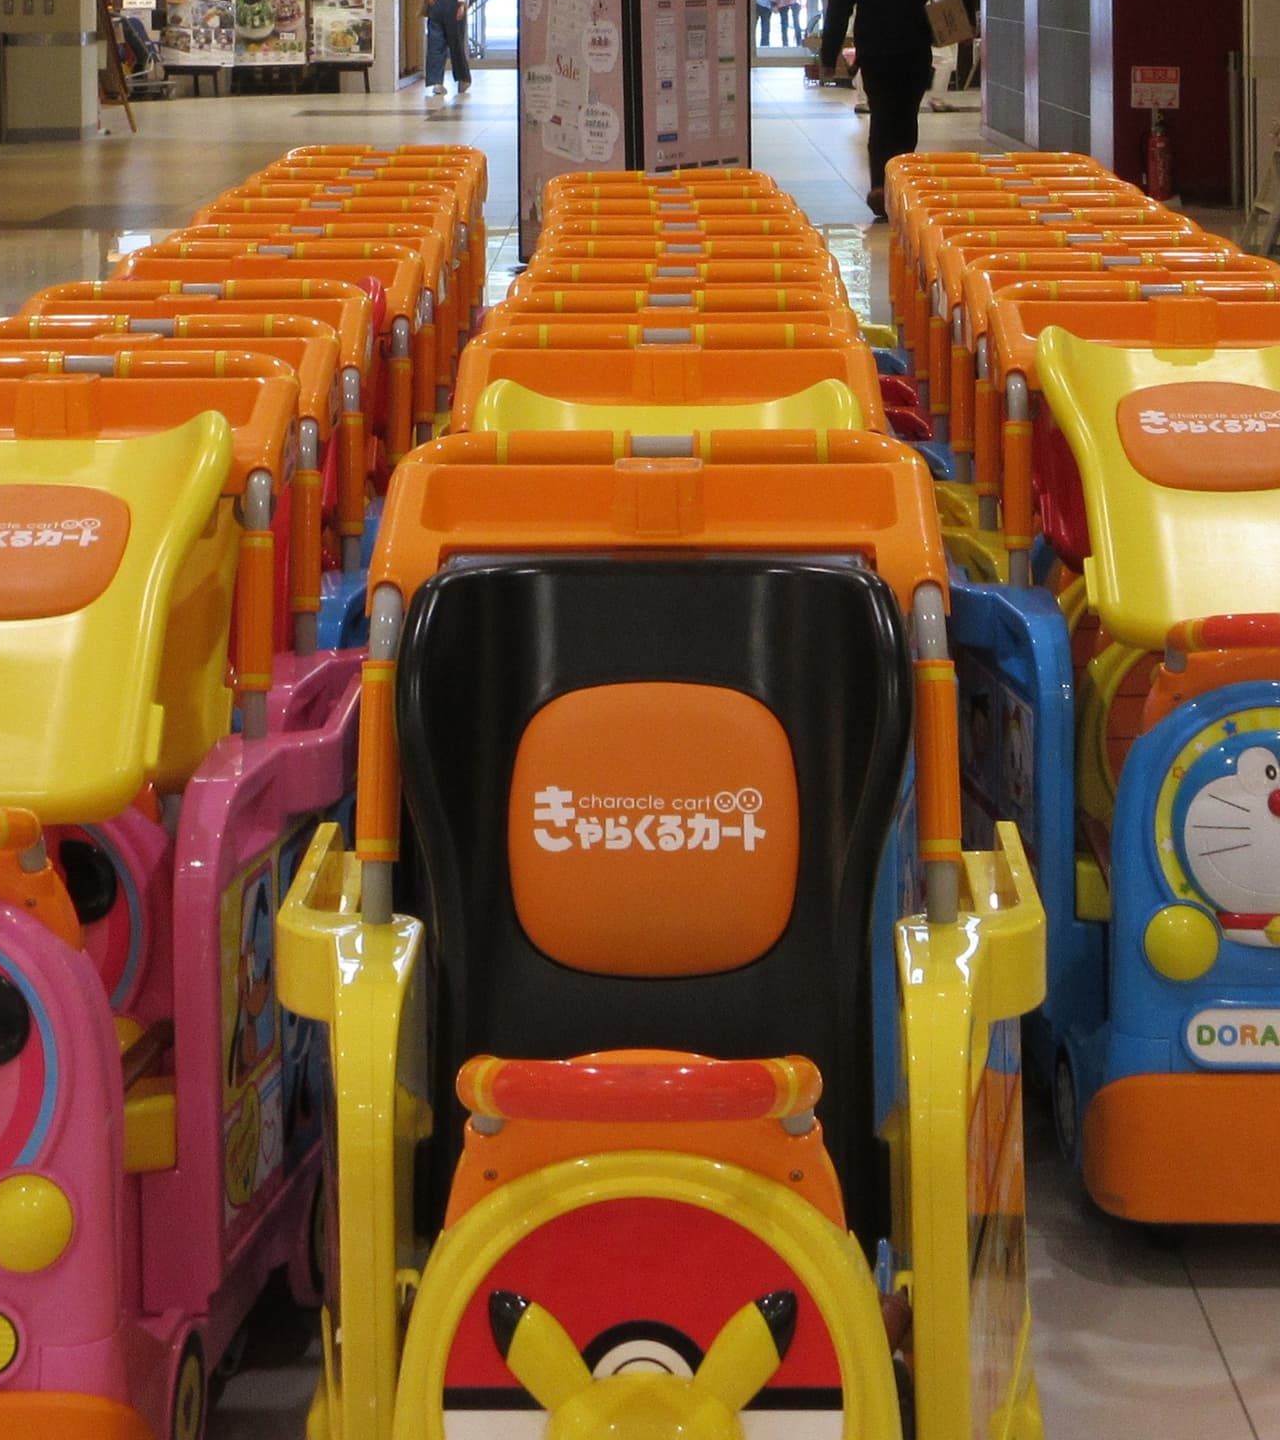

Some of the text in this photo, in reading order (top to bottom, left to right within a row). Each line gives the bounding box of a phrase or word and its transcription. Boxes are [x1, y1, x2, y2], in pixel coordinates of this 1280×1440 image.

[556, 54, 579, 82] Sale
[1169, 411, 1228, 419] characle
[26, 521, 59, 529] cart
[578, 794, 710, 811] characle cart
[533, 786, 766, 852] きゃらくるカート
